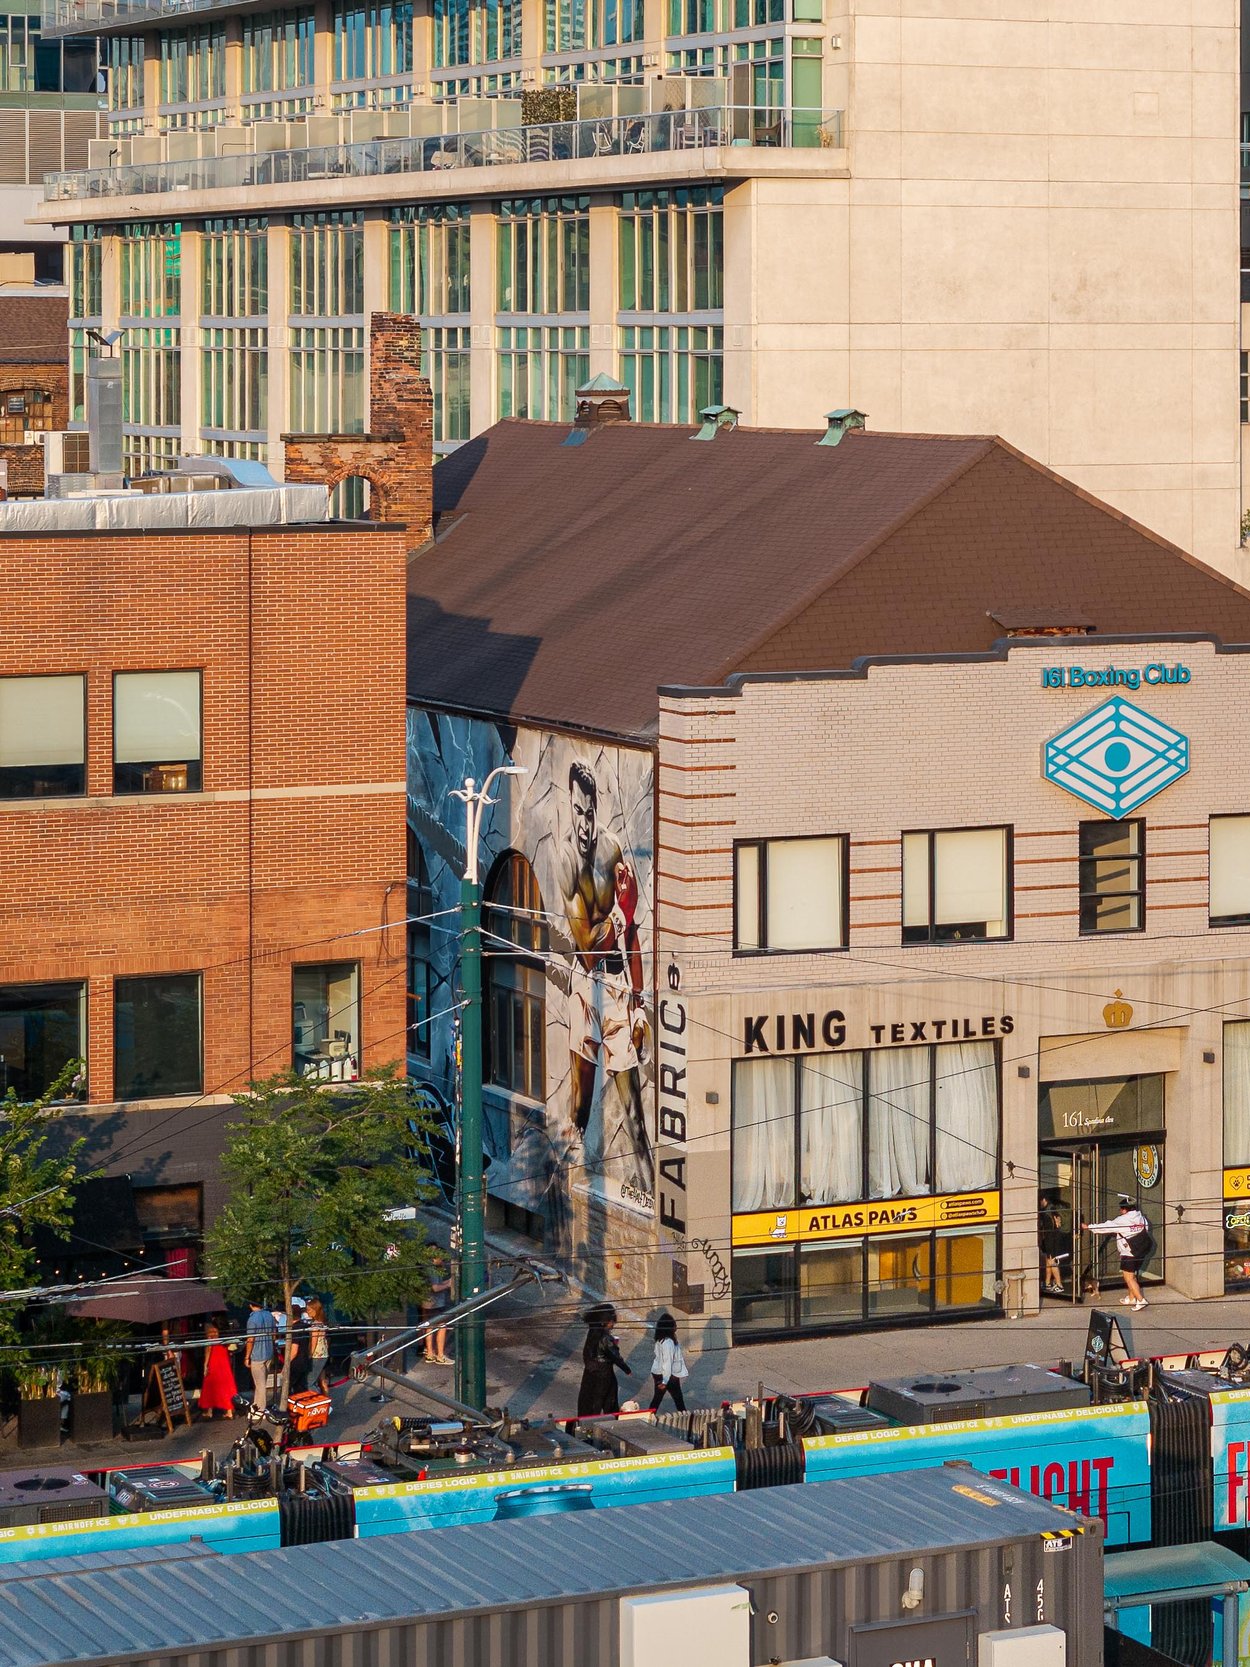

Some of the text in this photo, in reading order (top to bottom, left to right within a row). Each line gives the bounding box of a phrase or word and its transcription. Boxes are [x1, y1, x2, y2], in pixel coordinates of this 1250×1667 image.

[1070, 665, 1141, 690] Boxing
[1144, 663, 1191, 685] Club
[743, 1009, 1014, 1054] KING TEXTILES
[659, 999, 686, 1234] FABRIC
[1062, 1111, 1083, 1128] 161
[809, 1207, 918, 1231] ATLAS PAWS
[834, 1433, 868, 1444] DEFIES
[871, 1429, 900, 1440] LOGIC
[966, 1420, 978, 1429] ICE
[1011, 1411, 1073, 1425] UNDEFINABLY
[1076, 1405, 1125, 1417] DELICIOUS
[355, 1488, 369, 1497] ICE
[406, 1481, 443, 1492] DEFIES
[445, 1477, 477, 1488] LOGIC
[549, 1467, 563, 1477] ICE
[598, 1455, 666, 1471] UNDEFINABLY
[669, 1449, 722, 1463] DELICIOUS
[52, 1520, 94, 1532] SMIRNOFF
[96, 1518, 110, 1527] ICE
[149, 1506, 224, 1521] UNDEFINABLY
[227, 1499, 278, 1513] DELICIOU
